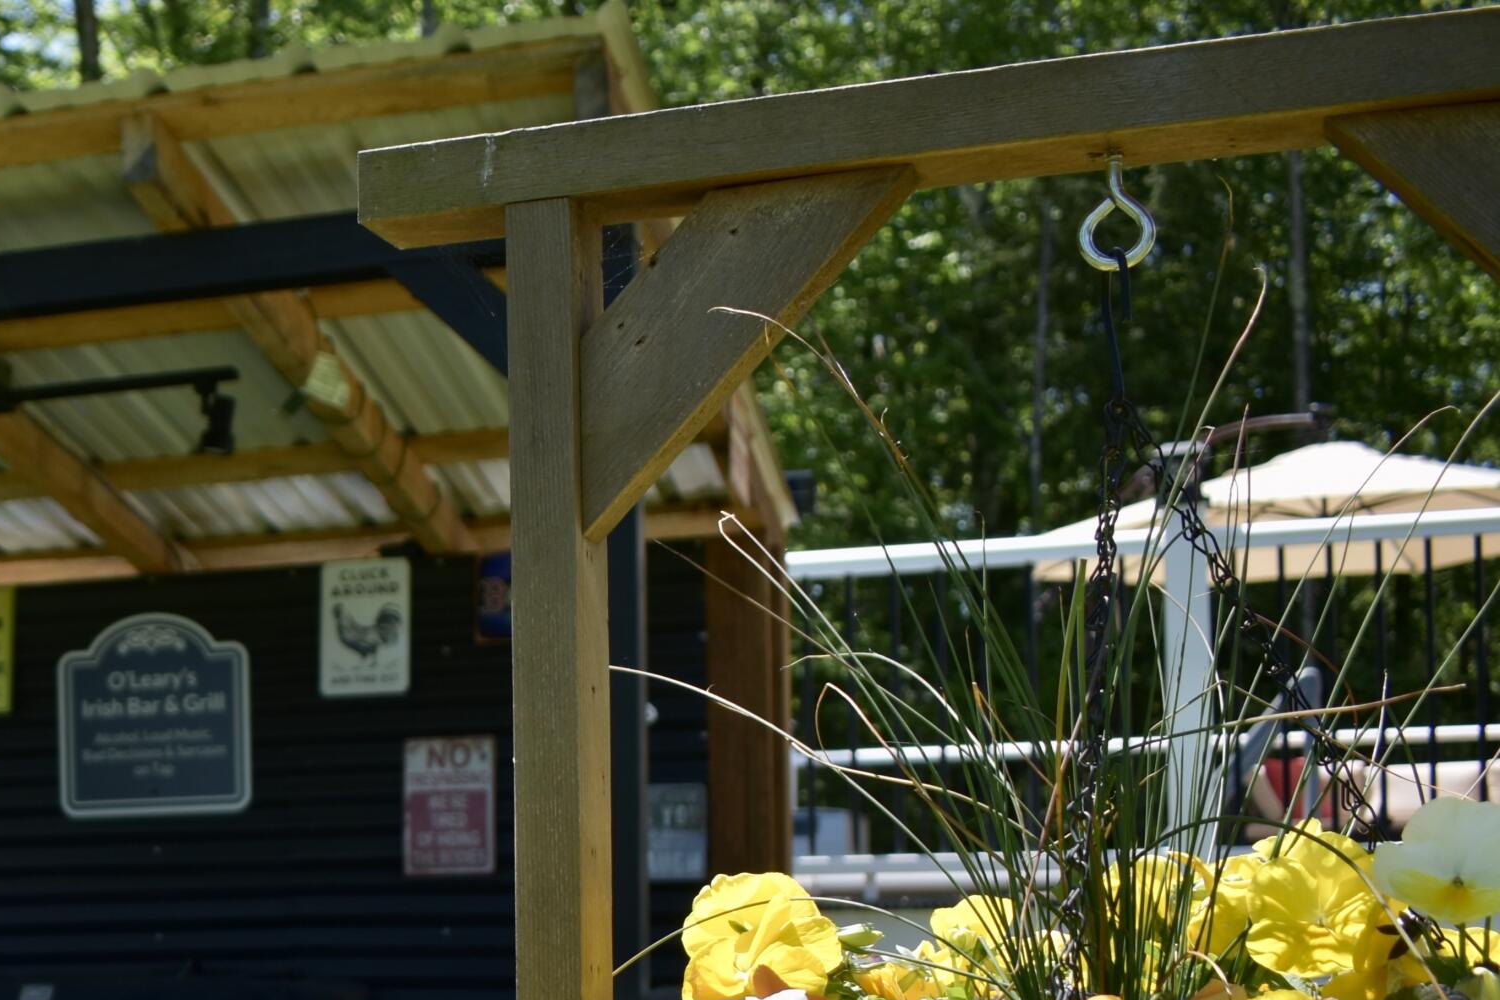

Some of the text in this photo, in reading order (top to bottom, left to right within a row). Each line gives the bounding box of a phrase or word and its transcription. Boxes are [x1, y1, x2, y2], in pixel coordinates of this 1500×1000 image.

[341, 567, 389, 580] CLUCK
[332, 582, 399, 595] AROUND
[107, 667, 198, 690] O'Leary's
[82, 691, 226, 717] Irish Bar & Grill
[426, 744, 471, 768] NO
